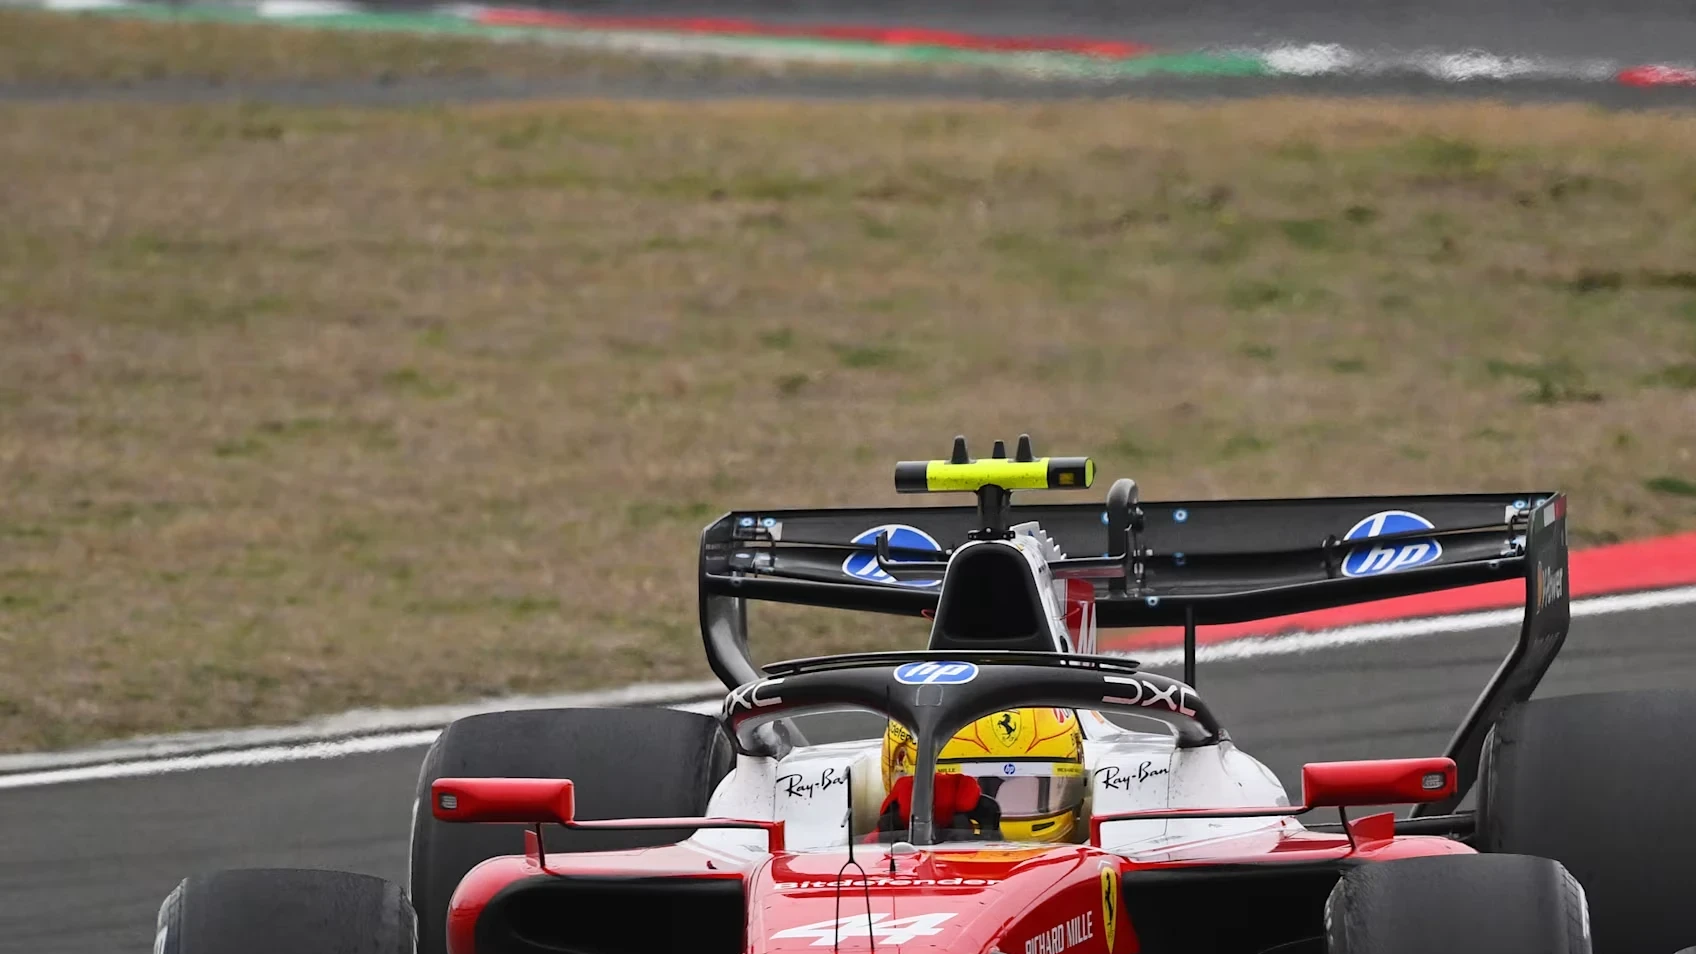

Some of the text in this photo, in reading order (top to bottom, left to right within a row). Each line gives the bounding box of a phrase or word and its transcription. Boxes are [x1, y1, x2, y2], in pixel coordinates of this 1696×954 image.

[1354, 512, 1430, 574] hp
[904, 661, 969, 684] hp
[1095, 761, 1169, 790] Ray-Ban
[773, 878, 1002, 890] Bitdefender
[769, 912, 959, 946] 44
[1067, 910, 1093, 948] MILLE
